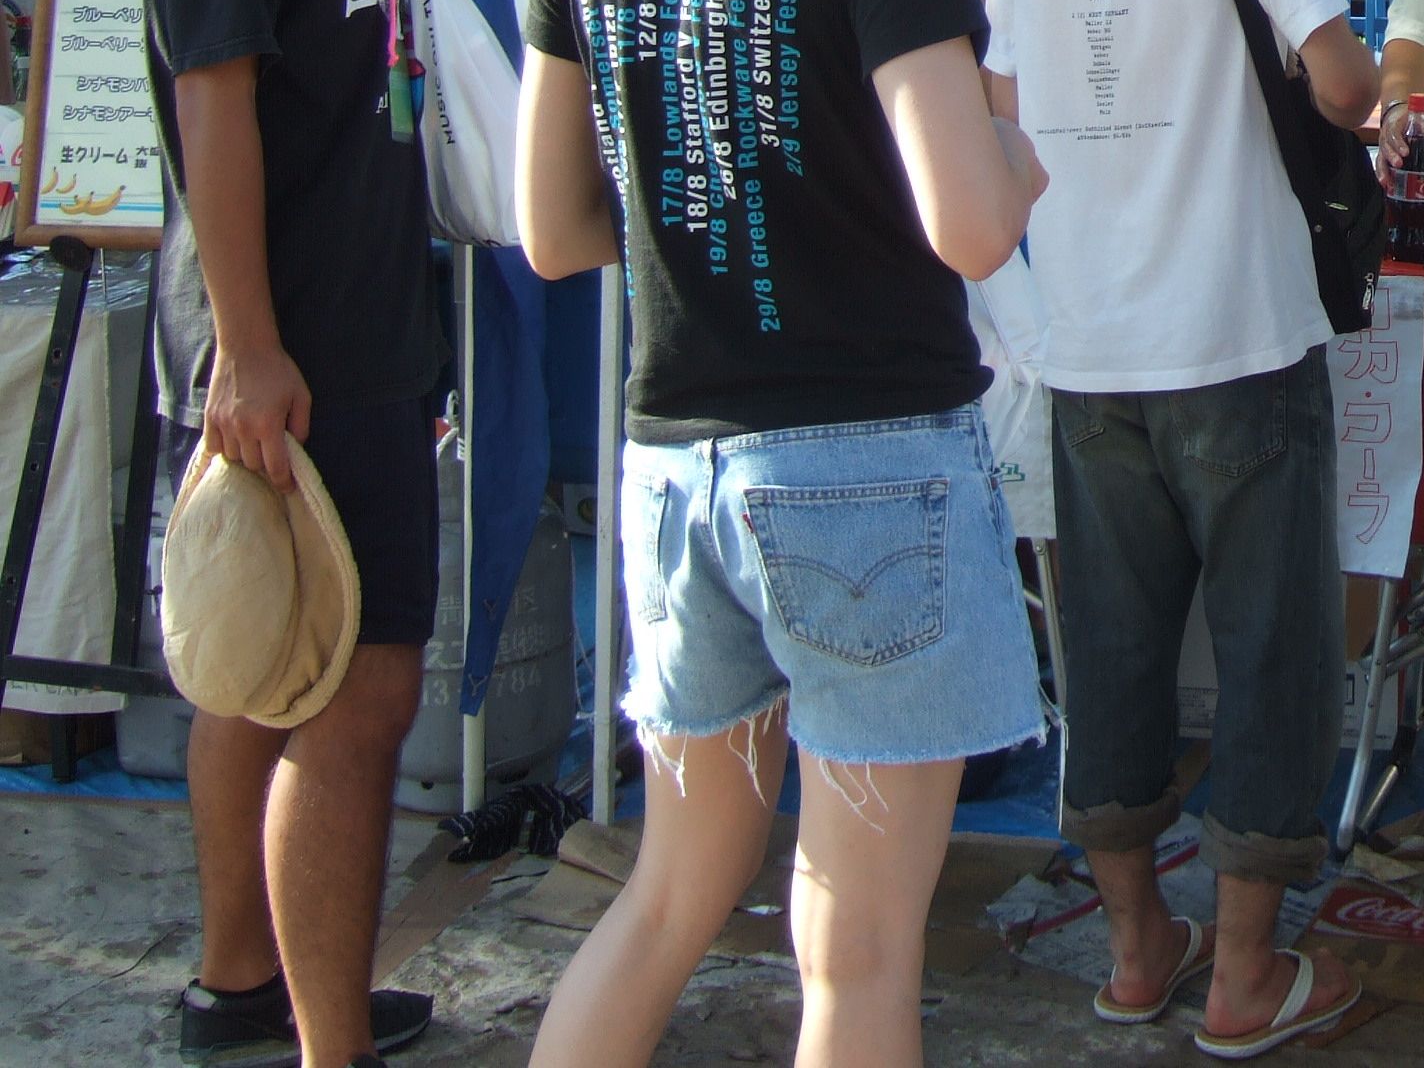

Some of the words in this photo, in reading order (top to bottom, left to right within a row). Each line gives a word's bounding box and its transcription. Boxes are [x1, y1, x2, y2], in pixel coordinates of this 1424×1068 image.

[61, 34, 145, 53] ブルーベリー
[617, 7, 636, 65] 11/8
[638, 2, 658, 62] 12/8
[434, 76, 456, 145] MUSIC
[660, 30, 685, 157] Lowlands
[676, 58, 706, 164] Stafford
[731, 38, 760, 169] Rockwave
[777, 44, 801, 130] Jersey
[755, 95, 780, 148] 31/8
[60, 145, 129, 164] 生クリーム
[712, 140, 737, 200] 26/8
[780, 138, 804, 177] 2/9
[661, 167, 684, 227] 17/8
[686, 174, 708, 233] 18/8
[744, 179, 770, 268] Greece
[710, 218, 729, 275] 19/8
[753, 278, 782, 332] 29/8
